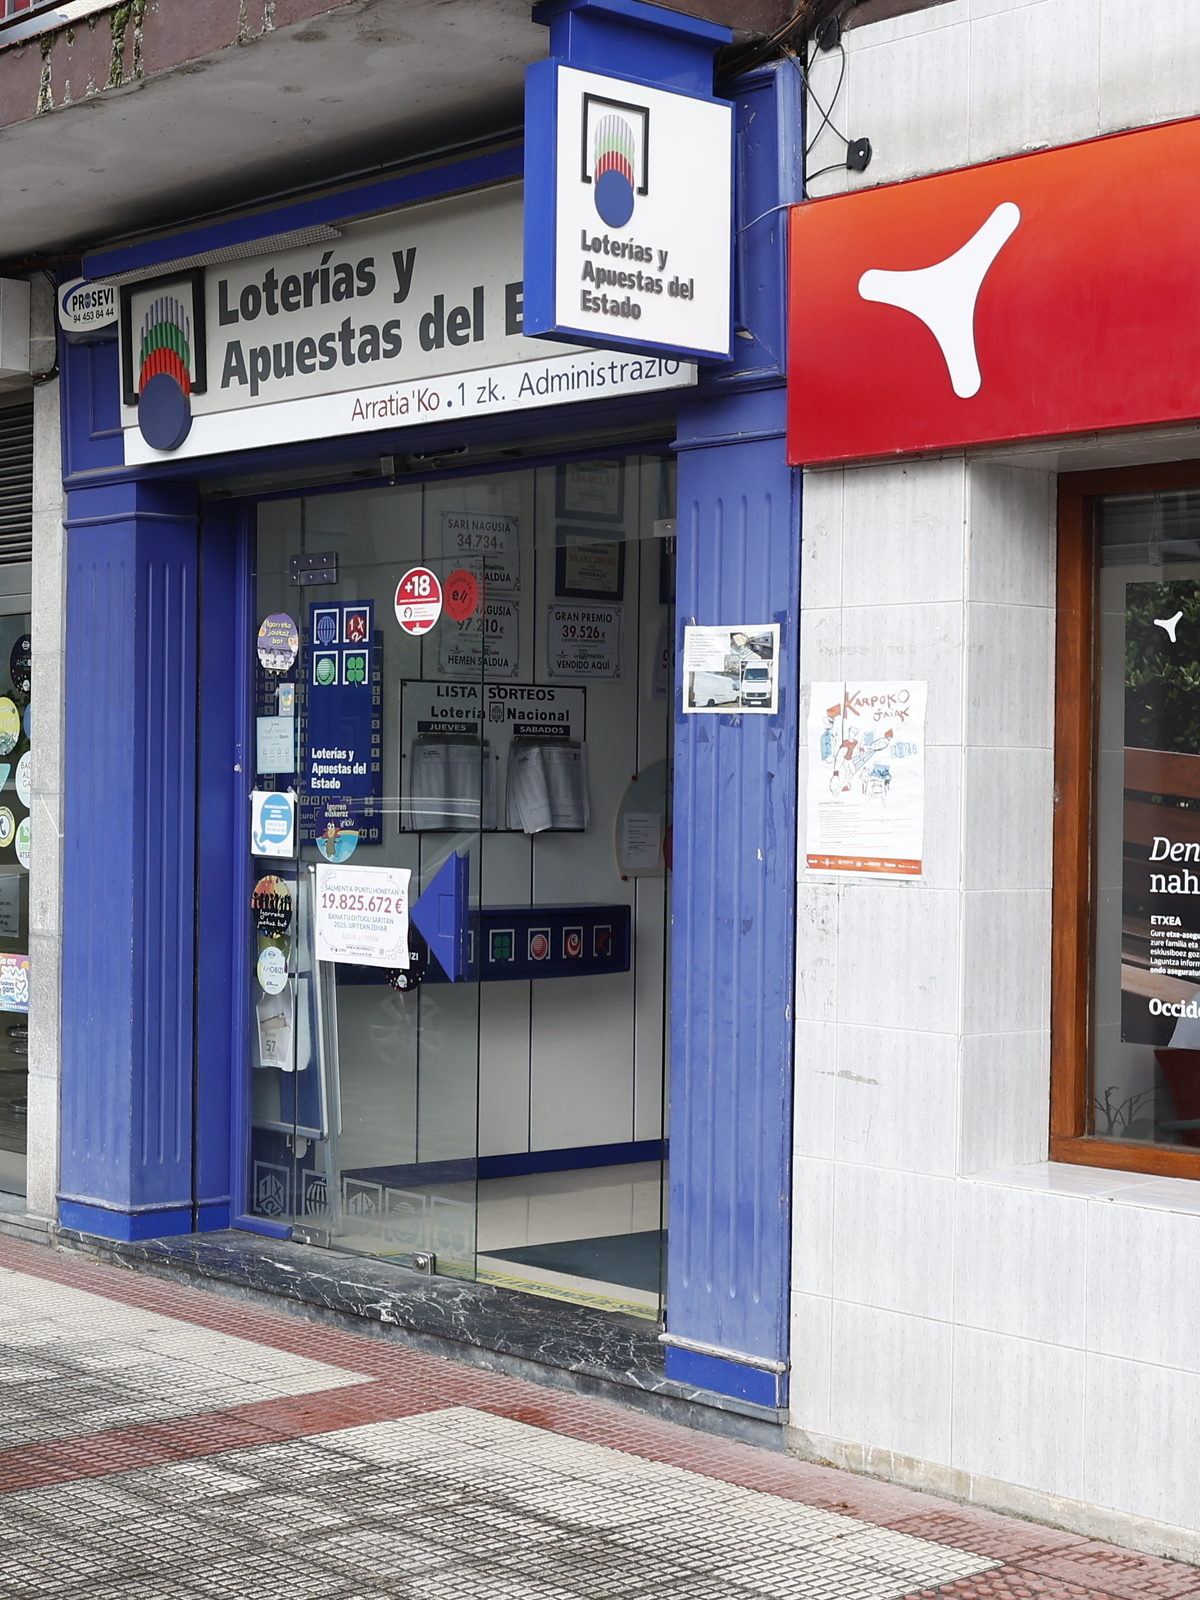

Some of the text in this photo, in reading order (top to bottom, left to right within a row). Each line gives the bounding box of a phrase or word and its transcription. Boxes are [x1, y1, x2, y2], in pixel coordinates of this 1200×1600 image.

[581, 229, 668, 271] Loterías y
[218, 246, 417, 327] Loterías y
[581, 260, 694, 301] Apuestas del
[72, 287, 114, 312] PROSEVI
[580, 289, 641, 320] Estado
[73, 314, 81, 324] 94
[82, 311, 94, 320] 453
[95, 309, 104, 319] 84
[105, 307, 114, 316] 44
[220, 281, 524, 397] Apuestas del E
[351, 388, 440, 421] Arratia'Ko
[476, 377, 505, 404] zk.
[518, 358, 680, 399] Administrazio
[448, 518, 511, 533] SARI NAGUSIA
[457, 533, 498, 549] 34.734
[404, 574, 431, 597] +18
[555, 611, 613, 623] GRAN PREMIO
[562, 624, 600, 639] 39.526
[15, 659, 31, 667] AHOB
[448, 655, 509, 667] HEMEN SALDUA
[556, 660, 610, 670] VENDIDO AQUÍ
[436, 685, 556, 701] LISTA SORTEOS
[843, 689, 910, 720] KARPOKO
[431, 705, 570, 721] Lotería Nacional
[429, 723, 467, 732] JUEVES
[519, 726, 564, 734] SABADOS
[311, 747, 355, 762] Loterías y
[311, 762, 367, 777] Apuestas del
[311, 777, 341, 790] Estado
[324, 810, 349, 818] euskeraz
[326, 802, 347, 812] Igorren
[1149, 836, 1200, 863] Den
[1149, 869, 1200, 895] nah
[372, 887, 400, 896] HONETAN
[322, 892, 404, 914] 19.825.672 €
[259, 909, 285, 920] Igorreko
[328, 913, 394, 925] BANATU DITUGU SARITAN
[1150, 915, 1182, 926] ETXEA
[333, 921, 388, 932] 2025. URTEAN ZEHAR
[1150, 929, 1166, 937] Gure
[1150, 939, 1199, 949] zure familia eta
[1150, 948, 1187, 957] esklusiboez
[1150, 957, 1180, 966] Laguntza
[262, 965, 284, 975] AHOBIZI
[1150, 966, 1167, 974] ondo
[1149, 998, 1200, 1019] Occid
[266, 1040, 276, 1053] 57
